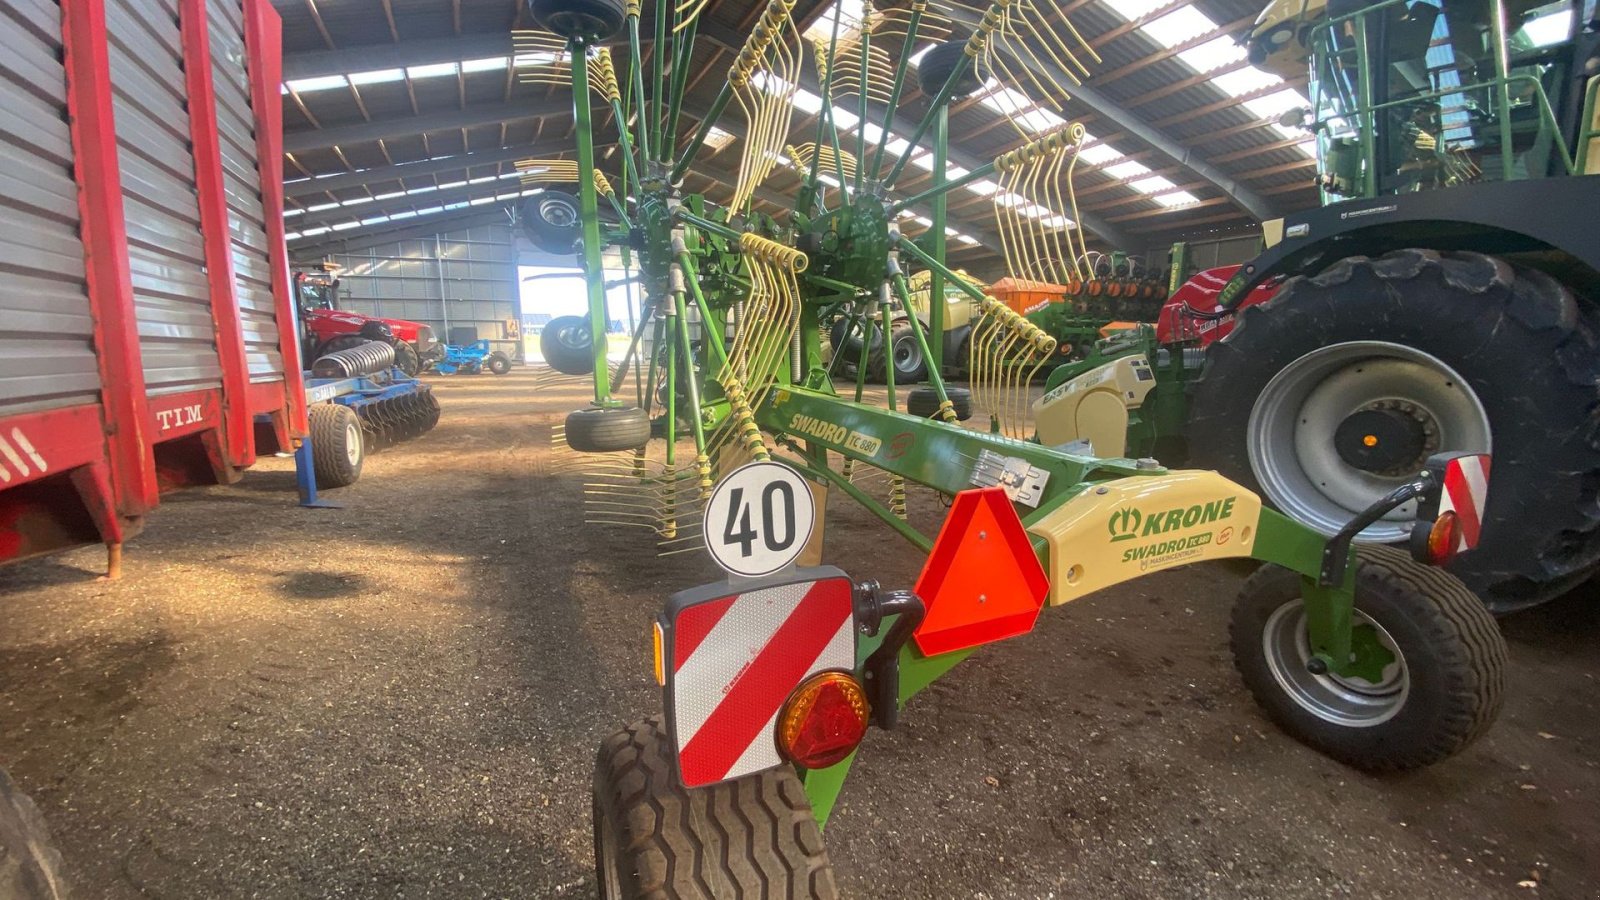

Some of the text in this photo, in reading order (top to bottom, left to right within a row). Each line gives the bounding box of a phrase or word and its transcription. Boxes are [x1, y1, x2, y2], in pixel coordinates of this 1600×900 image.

[156, 404, 203, 430] TIM
[789, 413, 847, 444] SWADRO
[859, 437, 877, 454] 880
[723, 480, 796, 558] 40
[1141, 496, 1236, 536] KRONE
[1122, 538, 1187, 562] SWADRO
